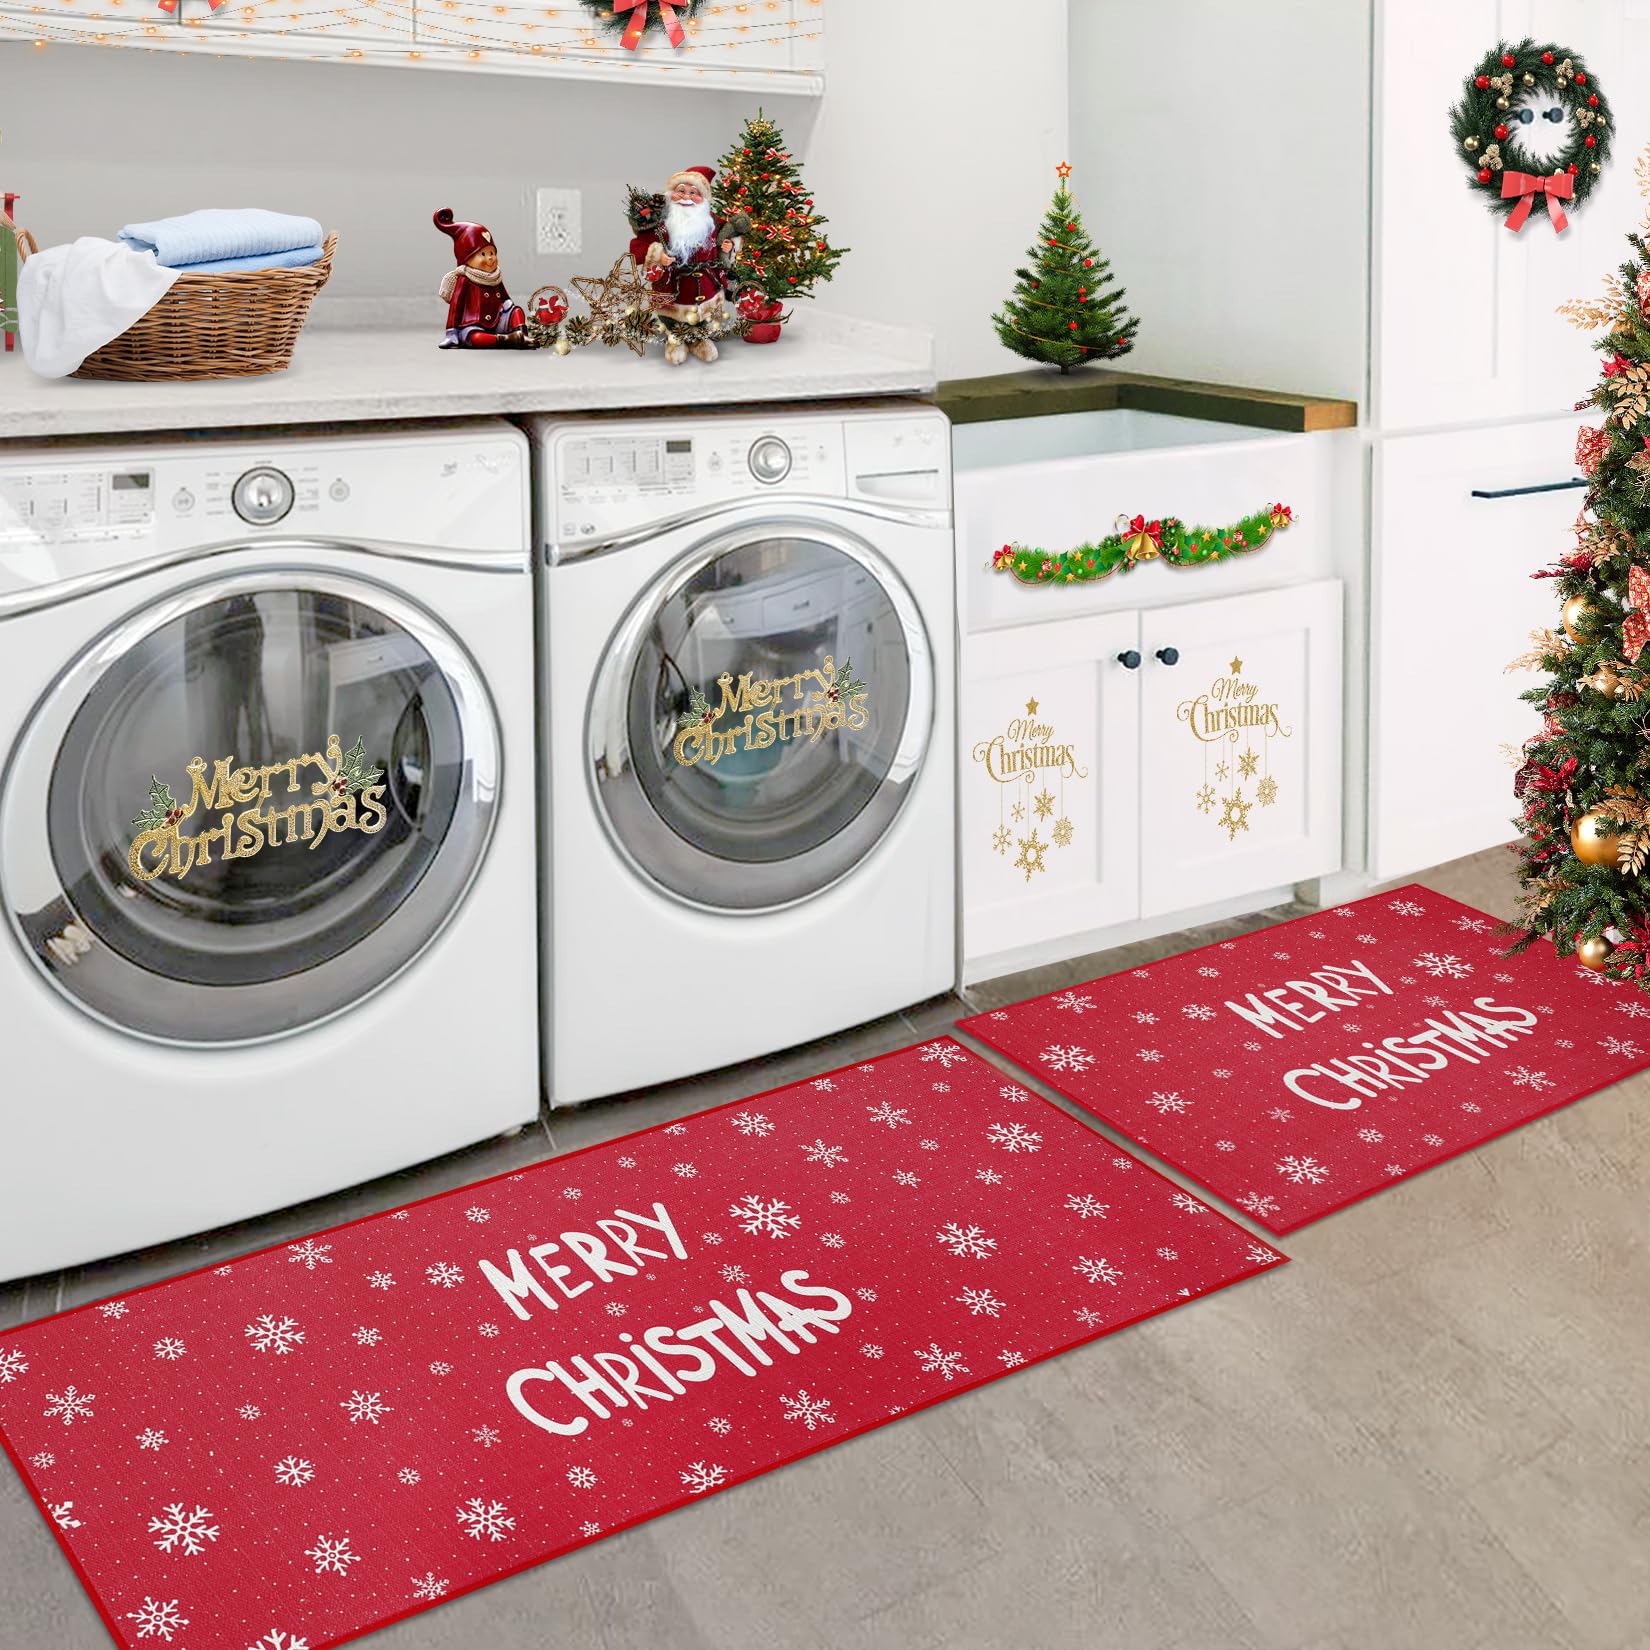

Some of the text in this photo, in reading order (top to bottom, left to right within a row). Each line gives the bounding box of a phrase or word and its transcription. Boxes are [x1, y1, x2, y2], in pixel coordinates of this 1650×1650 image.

[715, 656, 836, 718] Merry
[1176, 695, 1292, 742] Christmas
[1211, 678, 1259, 703] Merry
[673, 694, 870, 766] Christmas
[973, 735, 1088, 783] Christmas
[1007, 719, 1055, 744] Merry
[178, 735, 342, 818] Merry
[128, 785, 387, 881] Christmas
[1224, 960, 1393, 1039] MERRY
[478, 1202, 688, 1321] MERRY
